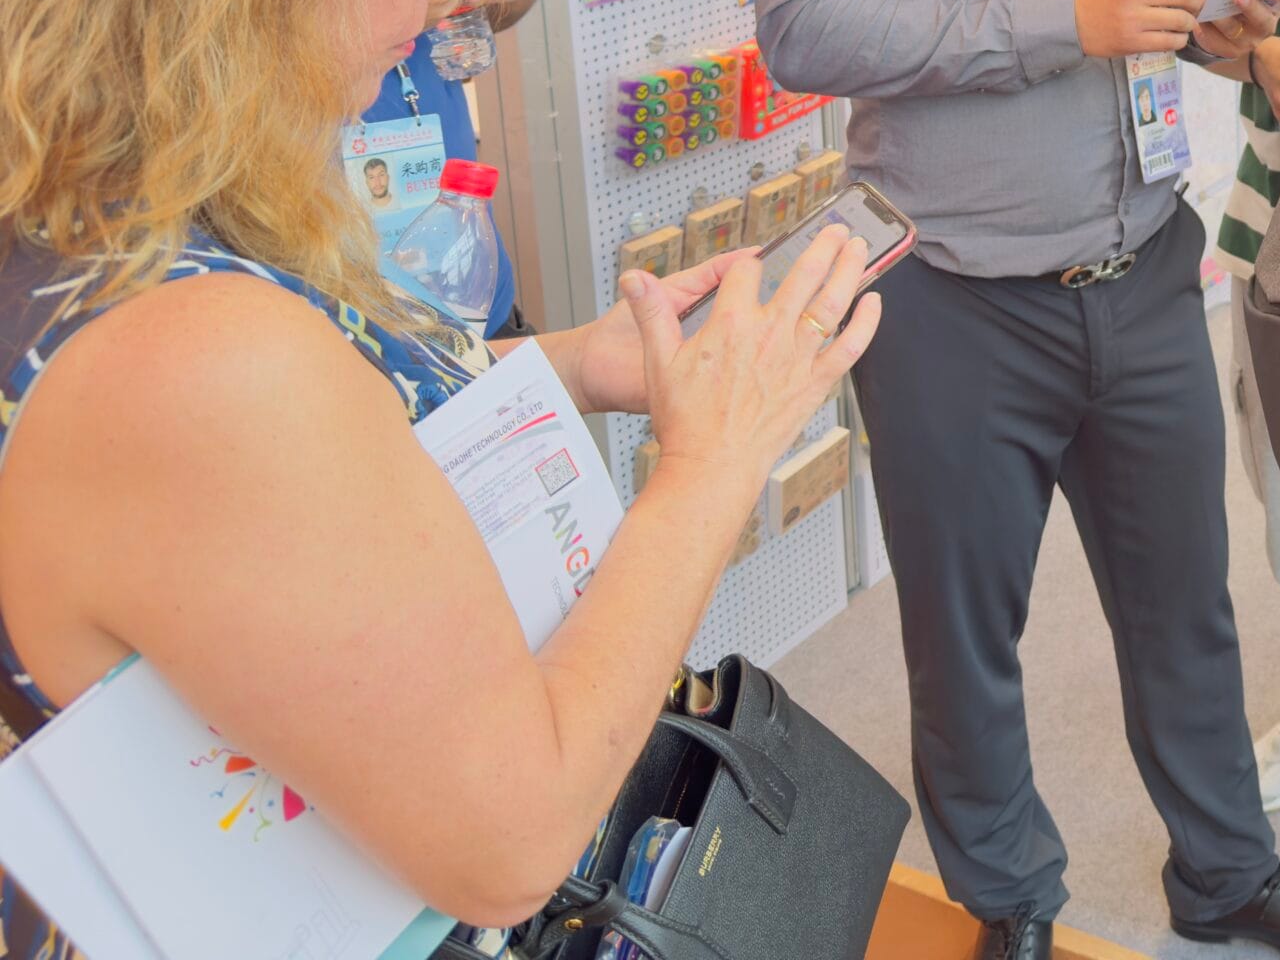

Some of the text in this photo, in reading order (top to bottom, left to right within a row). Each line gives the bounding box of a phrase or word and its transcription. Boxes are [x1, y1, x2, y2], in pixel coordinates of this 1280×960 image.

[401, 158, 441, 177] 采购商
[472, 418, 517, 453] TECHNOLOGY
[699, 826, 721, 877] BURBERRY
